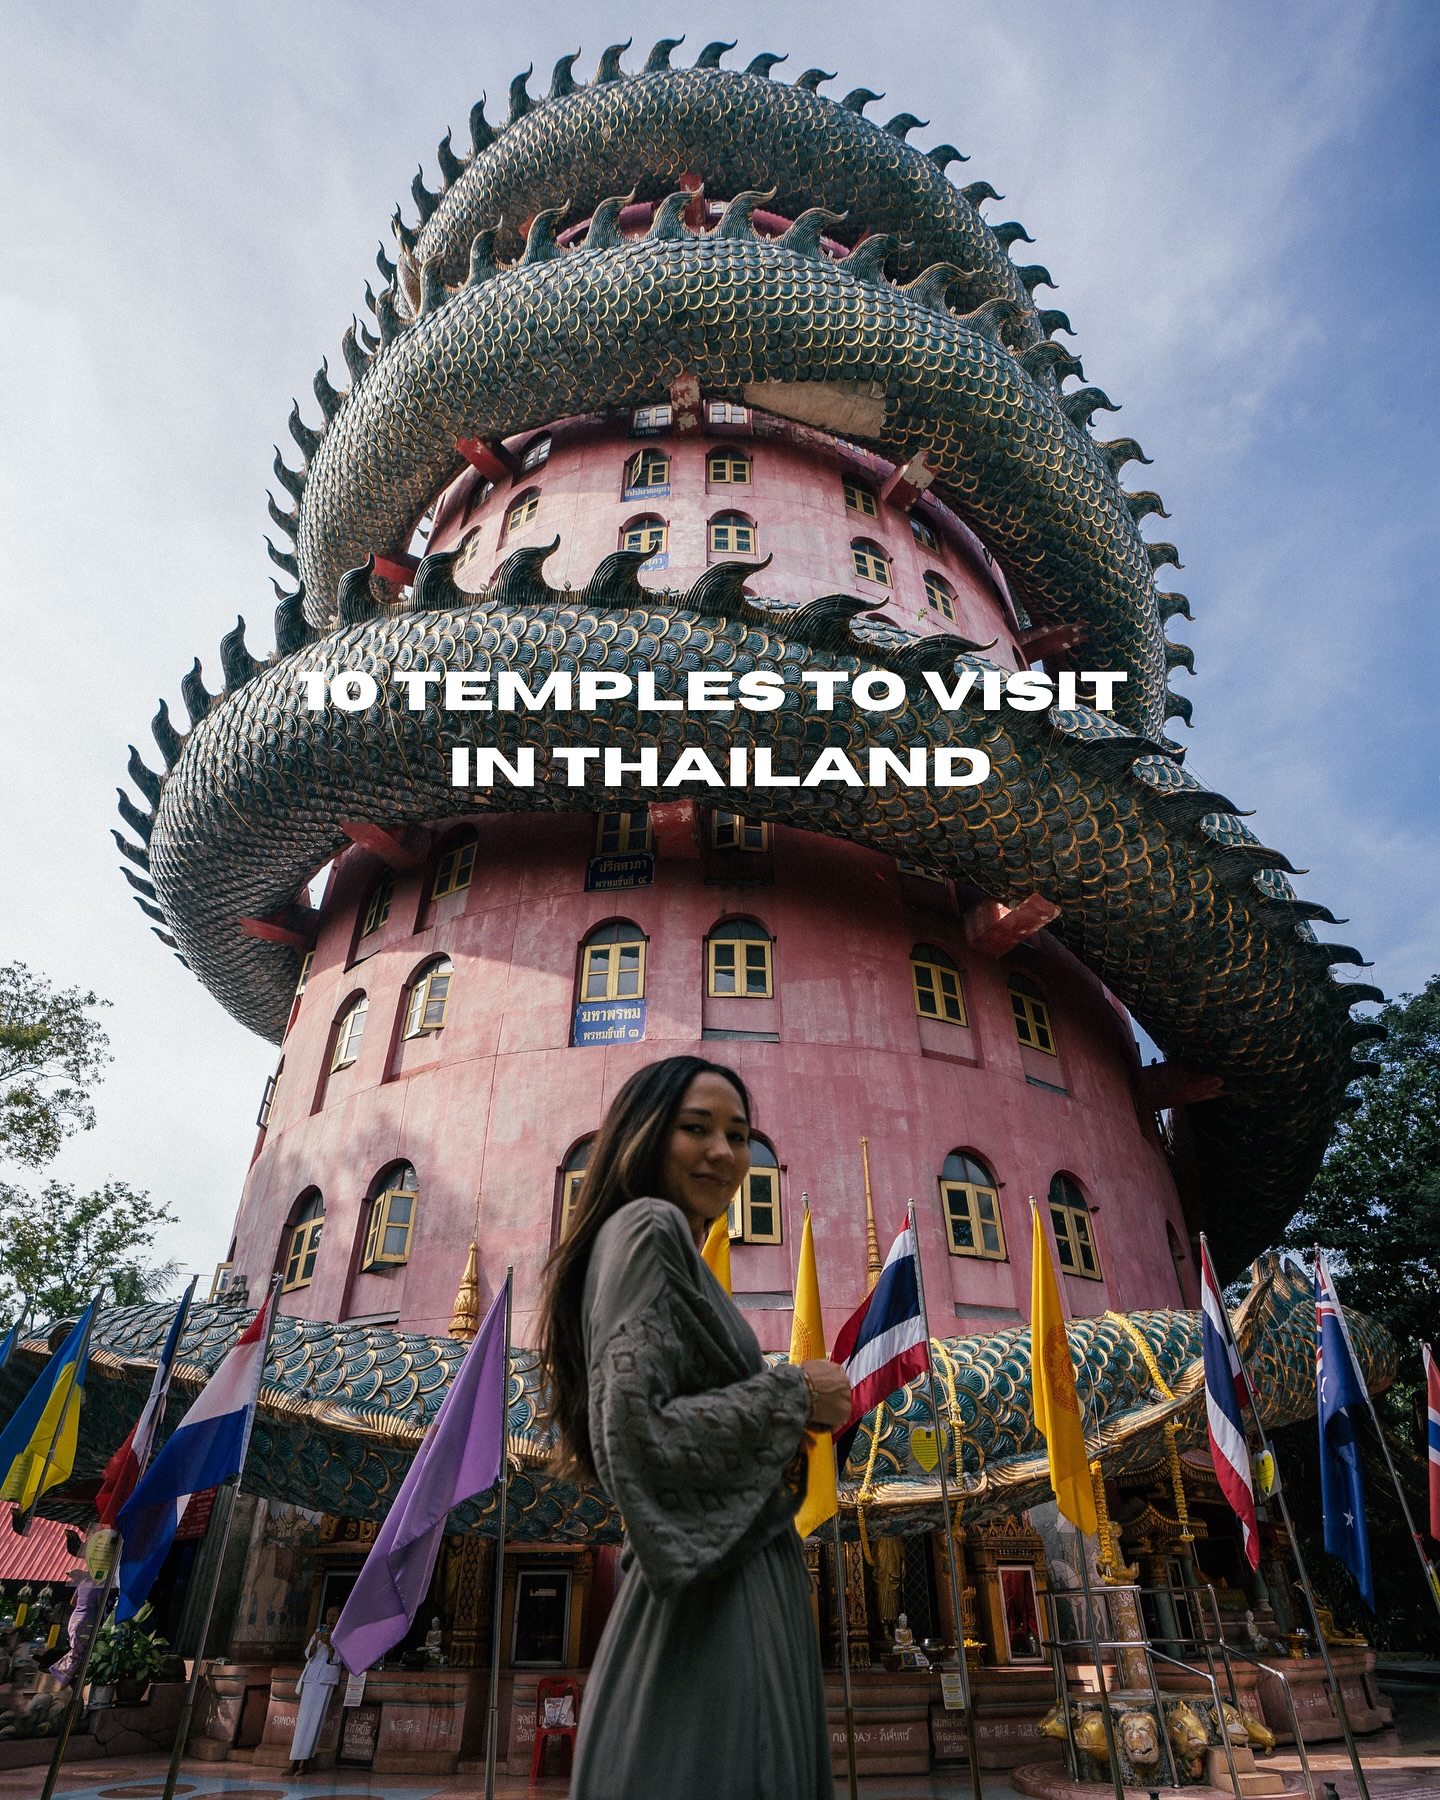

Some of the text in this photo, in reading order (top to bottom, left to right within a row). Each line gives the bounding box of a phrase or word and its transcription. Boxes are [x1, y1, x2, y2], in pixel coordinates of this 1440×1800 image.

[581, 1007, 641, 1023] มหาพรหม
[272, 1715, 298, 1727] SUNDA
